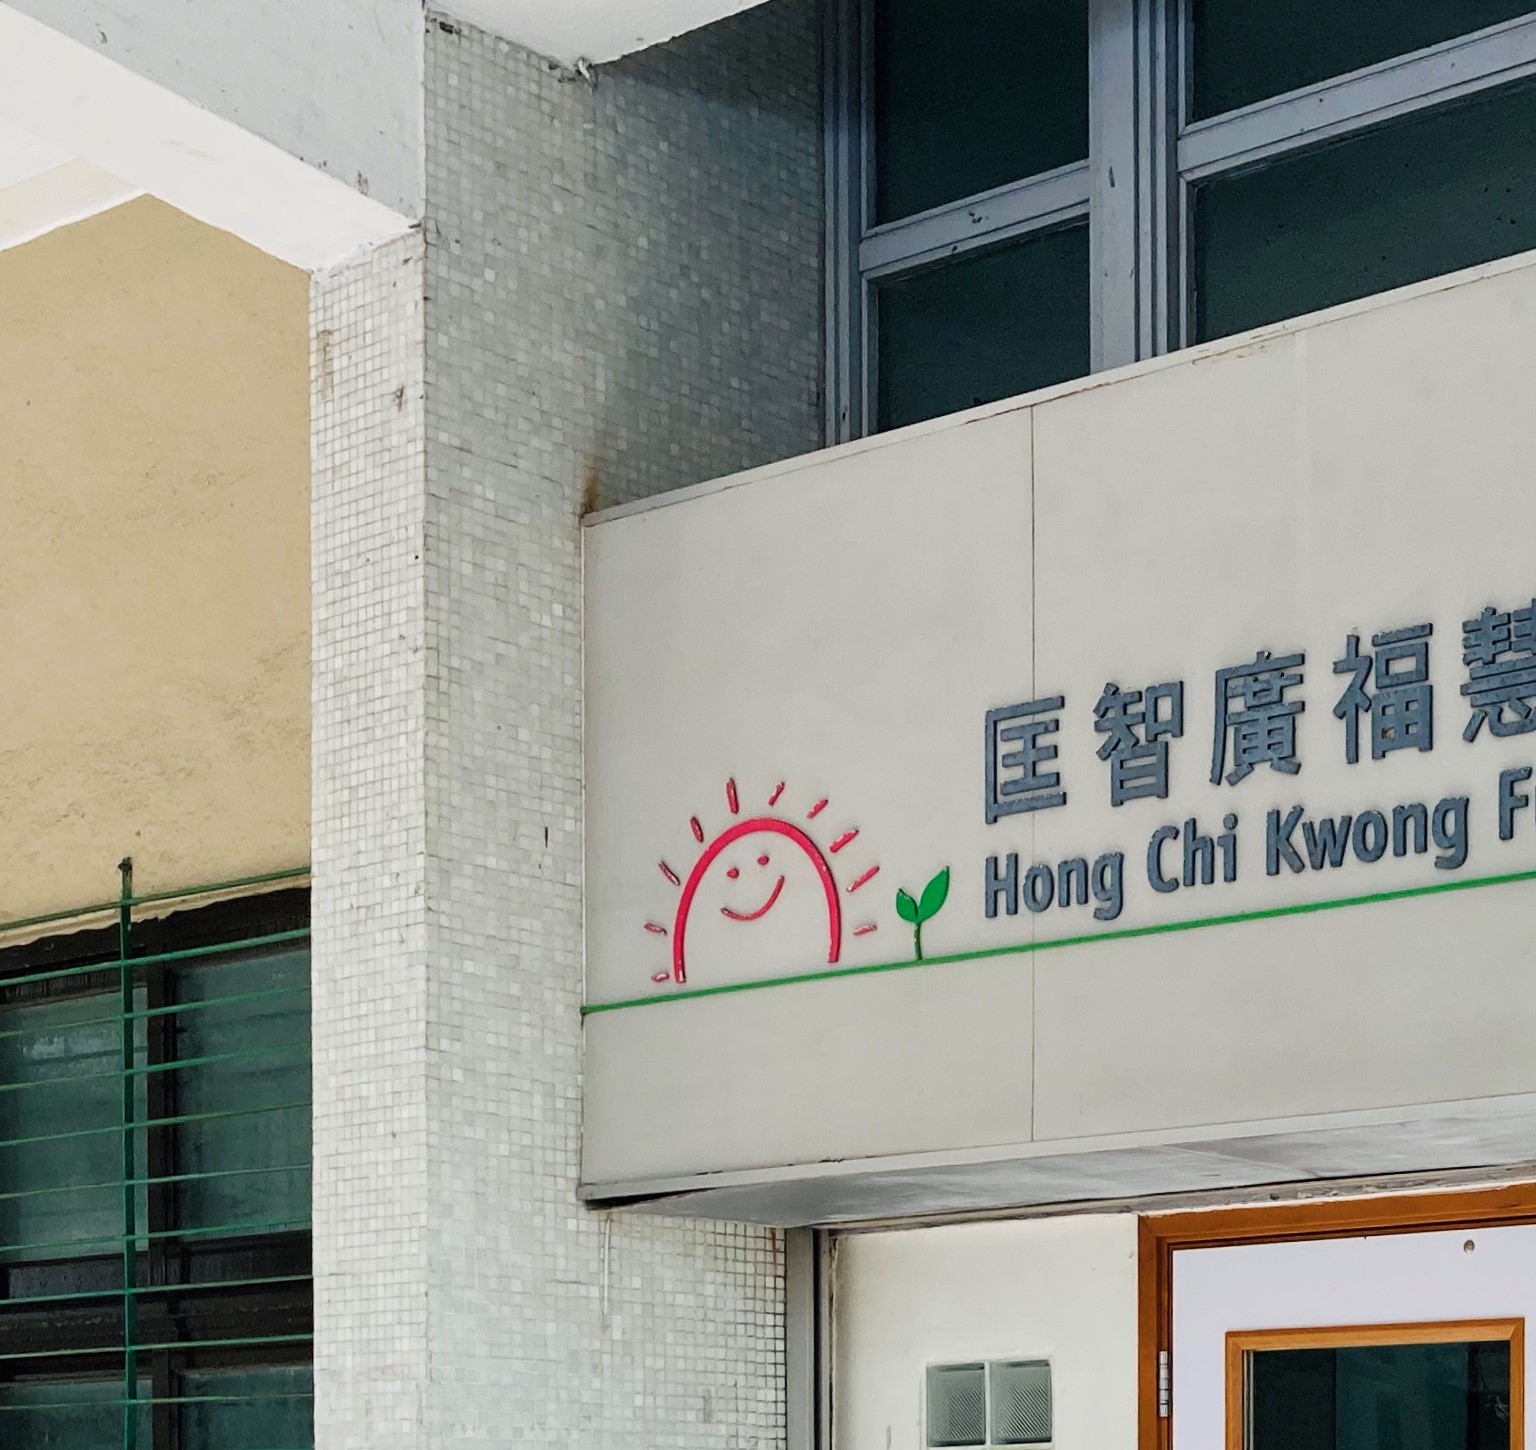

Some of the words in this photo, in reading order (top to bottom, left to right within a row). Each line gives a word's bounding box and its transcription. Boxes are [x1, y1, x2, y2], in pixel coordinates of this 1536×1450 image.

[984, 852, 1125, 922] Hong
[1146, 813, 1239, 894] Chi
[1265, 795, 1470, 877] Kwong
